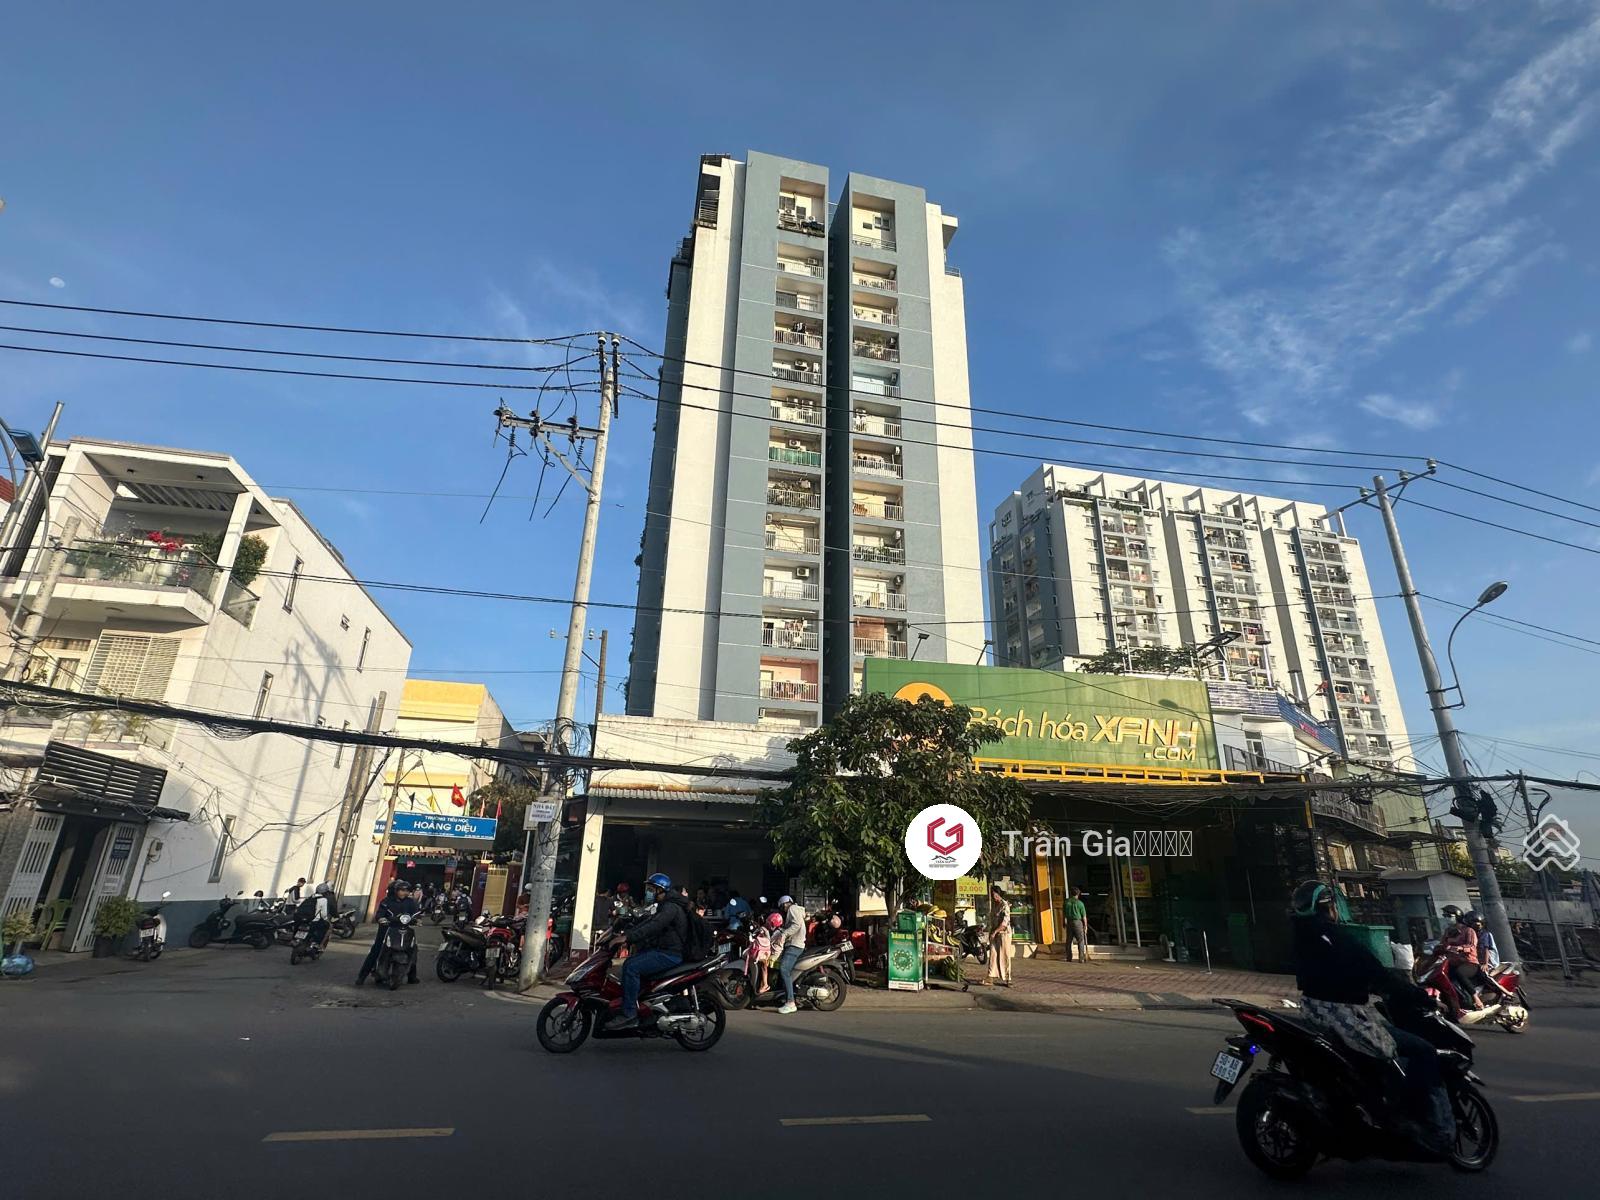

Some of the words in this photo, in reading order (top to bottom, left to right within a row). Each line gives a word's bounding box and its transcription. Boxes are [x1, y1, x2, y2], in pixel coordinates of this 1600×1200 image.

[967, 706, 1033, 737] Bách
[1038, 711, 1089, 742] hóa
[1090, 714, 1199, 747] XANH
[1143, 746, 1196, 761] .COM
[413, 819, 452, 831] HOÀNG
[454, 822, 477, 834] DIỆU
